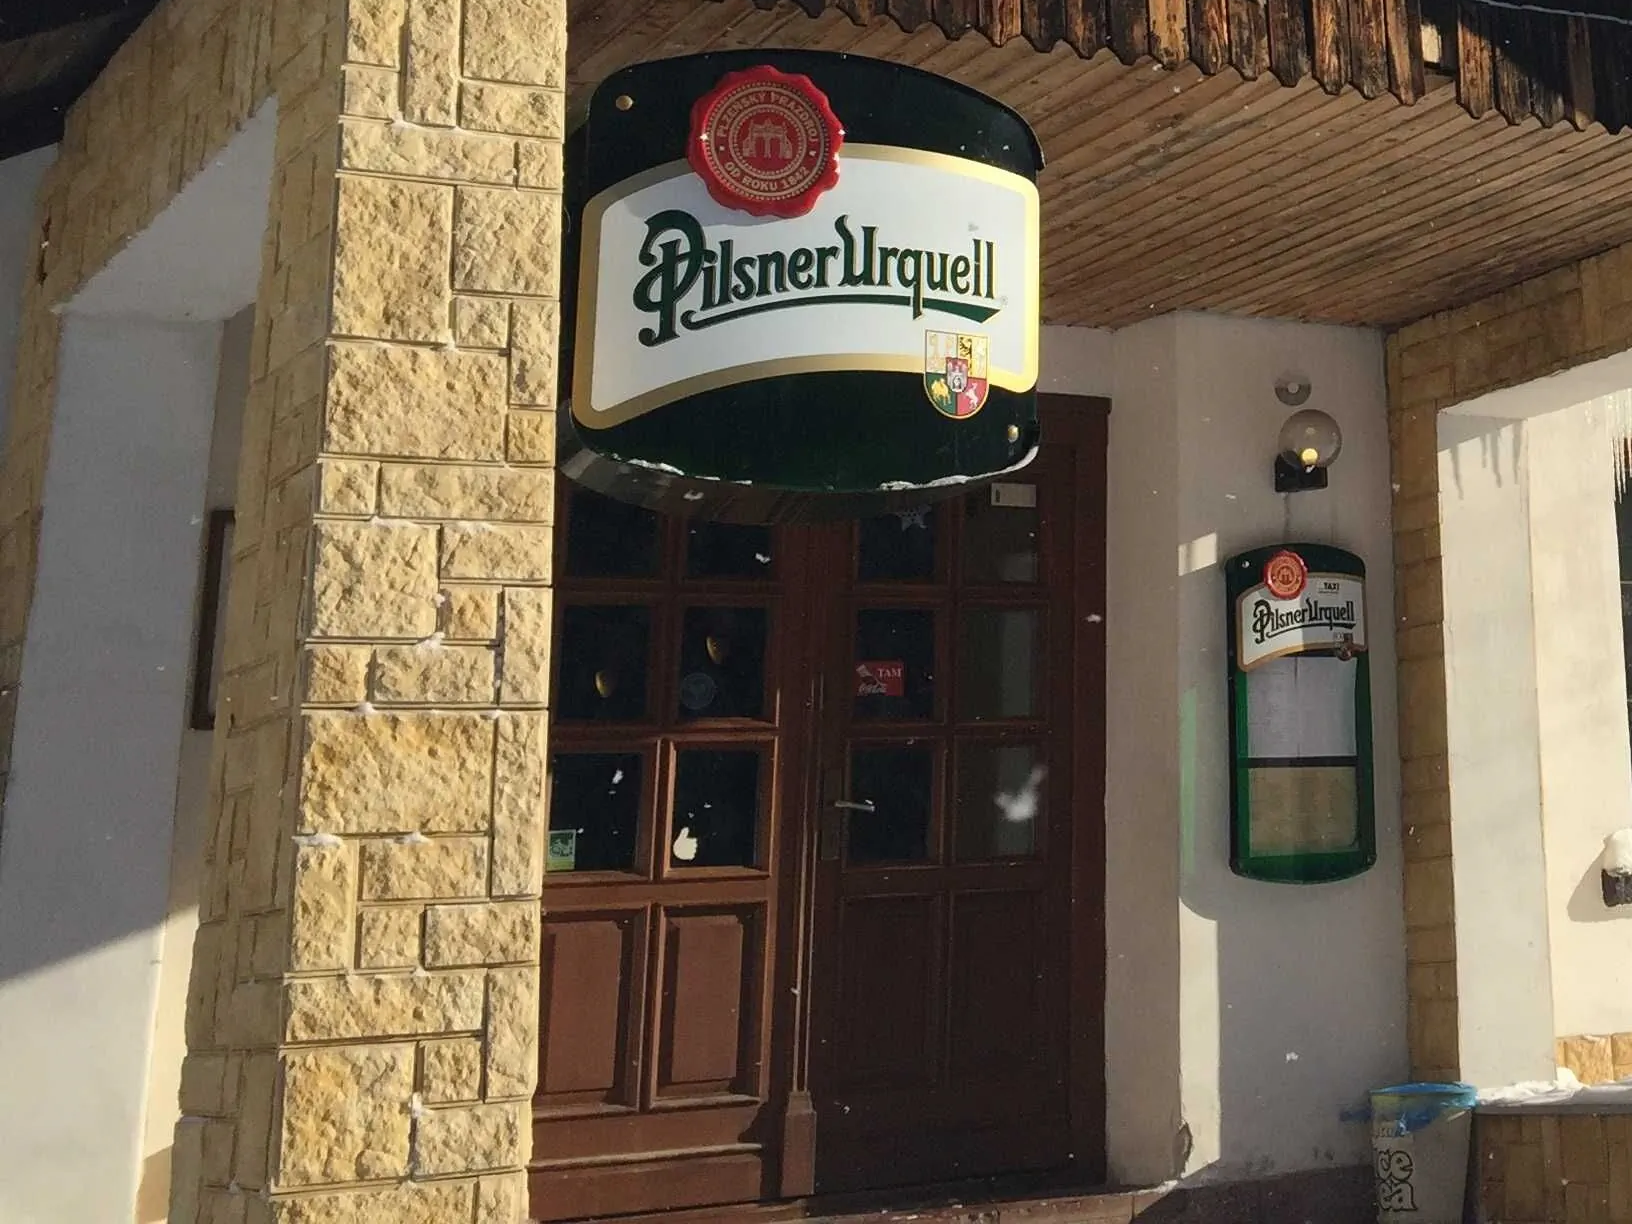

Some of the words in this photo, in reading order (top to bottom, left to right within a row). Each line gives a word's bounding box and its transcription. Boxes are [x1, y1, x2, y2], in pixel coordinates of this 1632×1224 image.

[742, 176, 778, 191] ROKU
[633, 209, 840, 347] Pilsner
[835, 214, 997, 320] Urquell
[1252, 599, 1309, 644] Pilsner
[1305, 597, 1355, 631] Urquell
